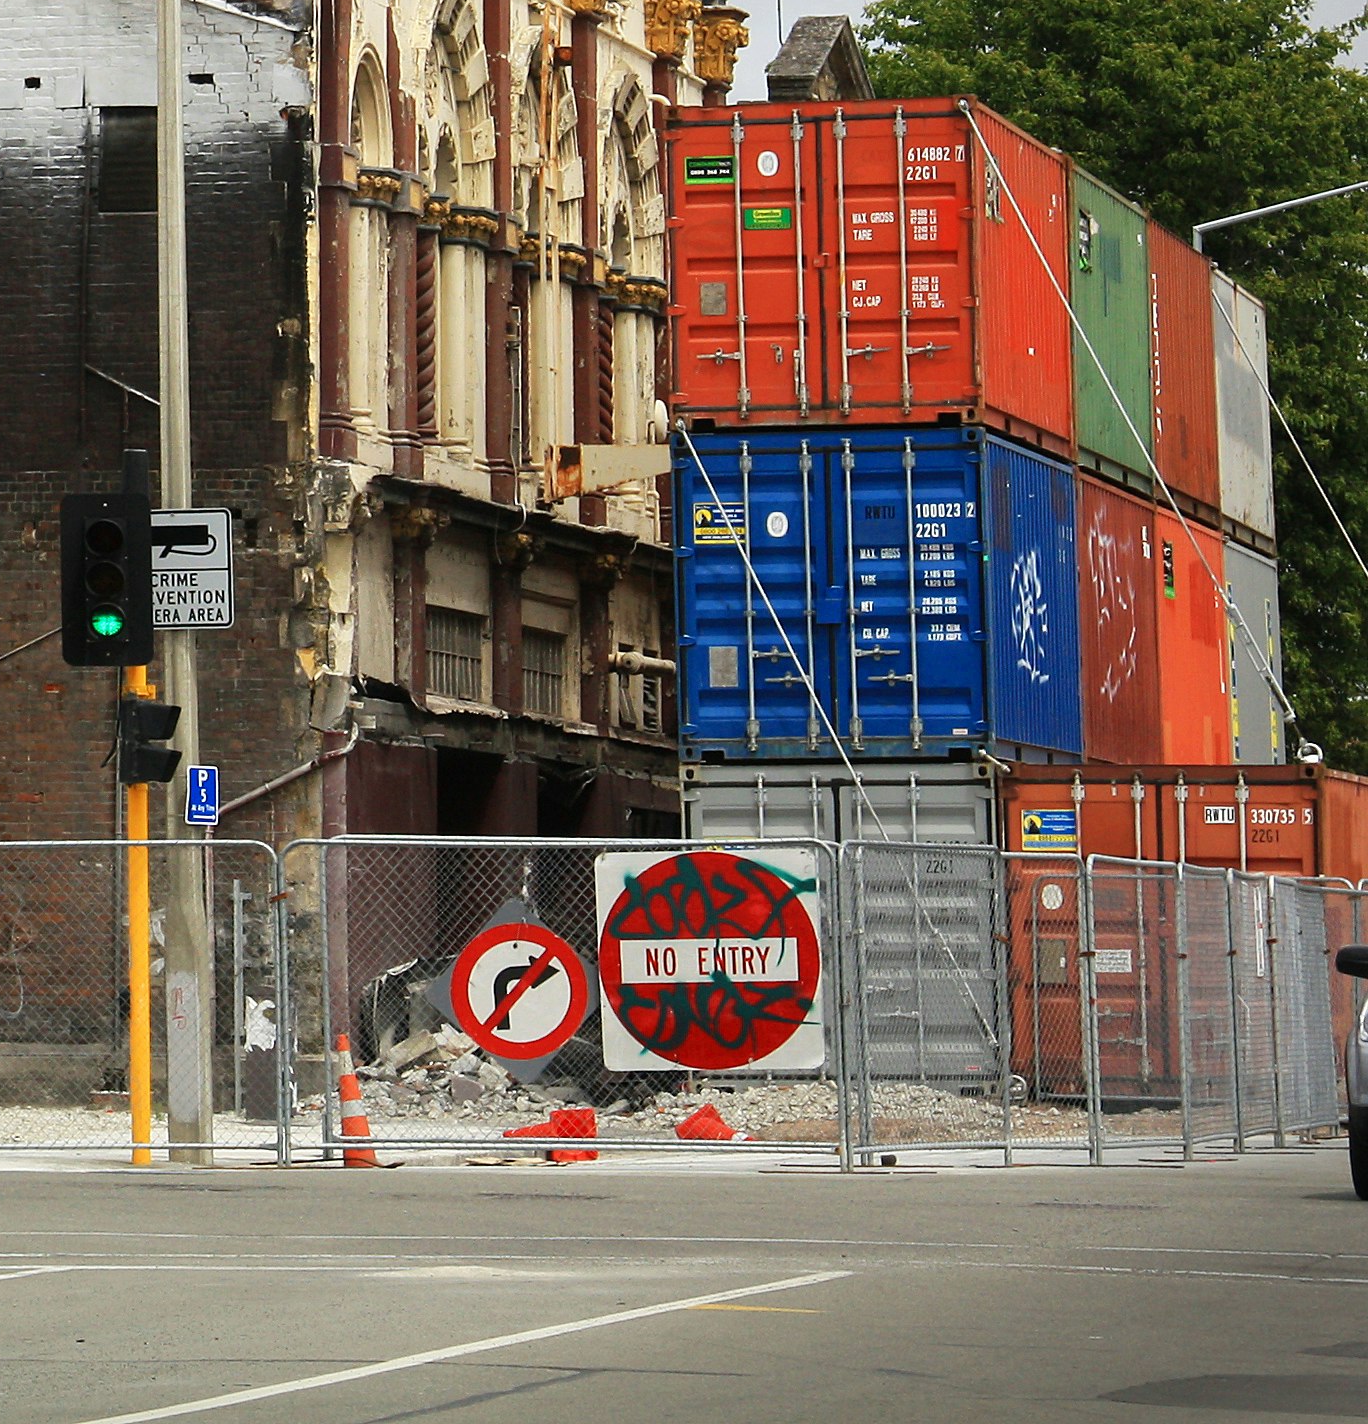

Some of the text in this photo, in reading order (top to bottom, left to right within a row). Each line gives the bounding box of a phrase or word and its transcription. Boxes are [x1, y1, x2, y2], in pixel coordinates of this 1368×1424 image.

[907, 147, 951, 162] 614882
[906, 166, 938, 181] 22G1
[853, 229, 873, 240] TARE
[852, 280, 867, 291] NET
[916, 503, 961, 518] 100023
[916, 523, 946, 538] 22G1
[152, 573, 198, 587] CRIME
[152, 590, 225, 605] VENTION
[154, 608, 224, 623] ERA AREA
[198, 770, 208, 787] P
[200, 788, 207, 803] 5
[1205, 807, 1312, 824] RWTU 330735 5
[1251, 829, 1280, 843] 22G1
[645, 946, 771, 976] NO ENTRY
